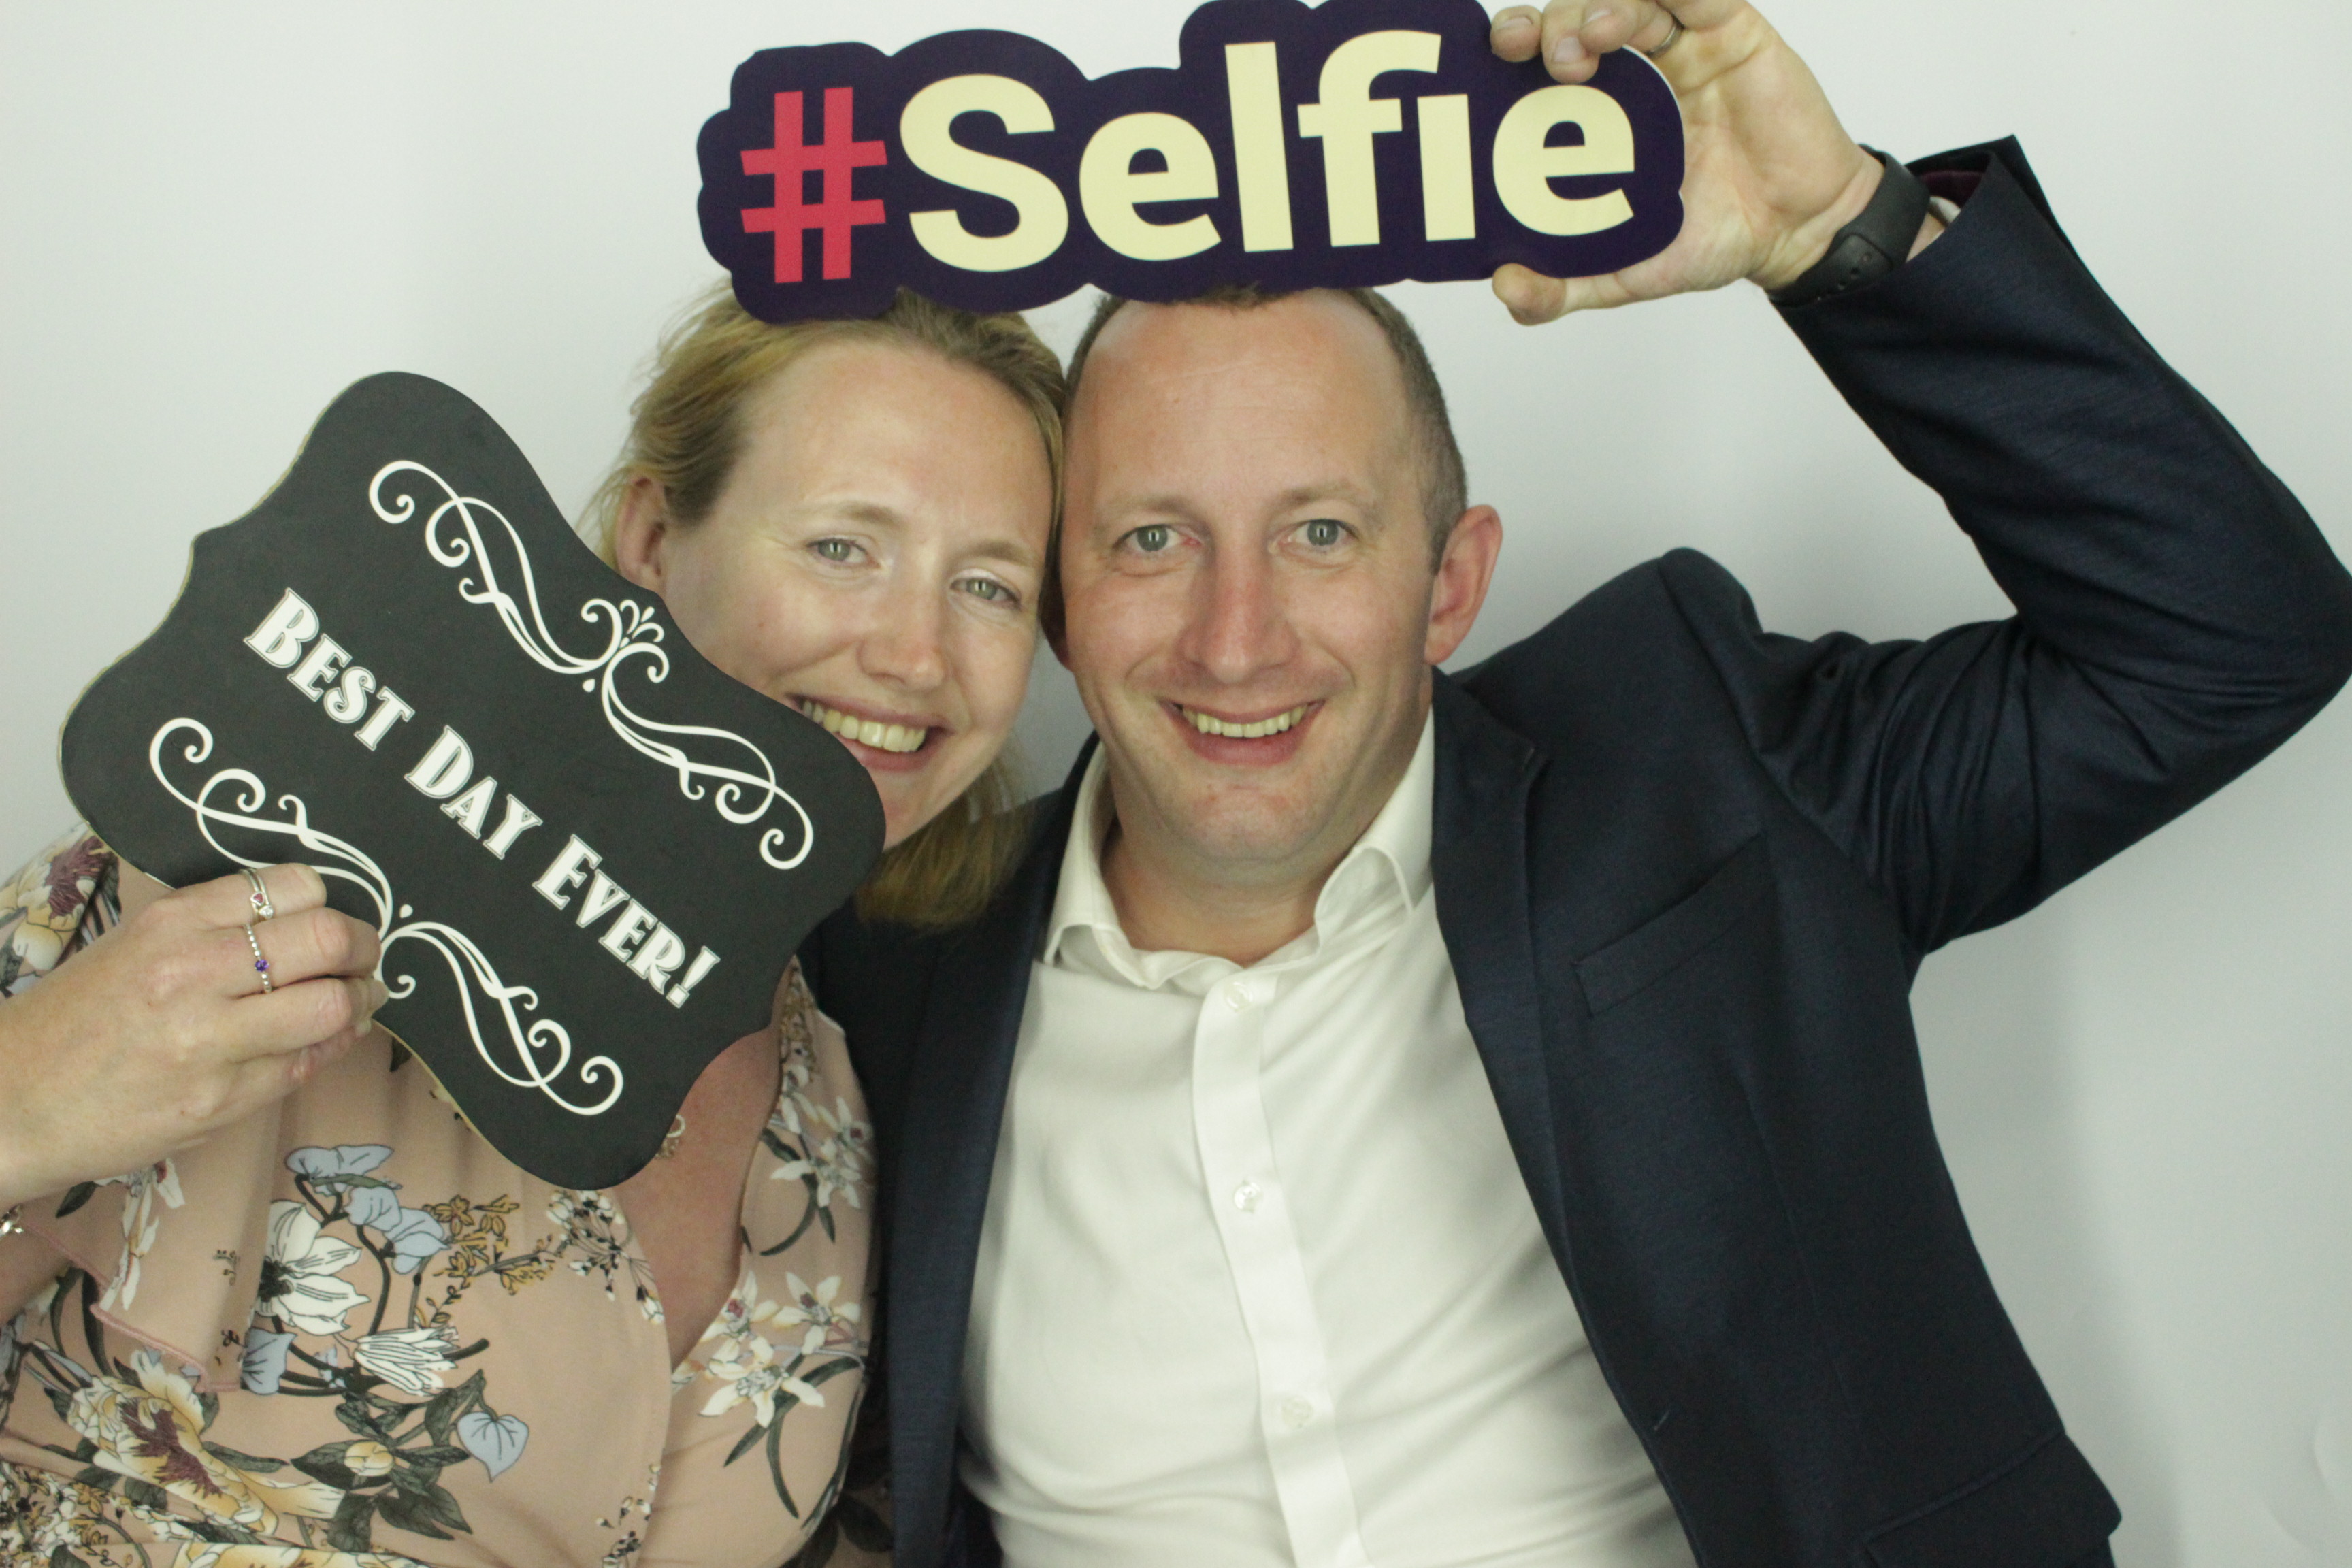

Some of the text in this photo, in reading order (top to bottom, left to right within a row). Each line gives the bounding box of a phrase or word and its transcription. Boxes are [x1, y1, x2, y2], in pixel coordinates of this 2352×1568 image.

[741, 31, 1635, 282] #Selfie
[244, 587, 721, 1009] BEST DAY EVER!
